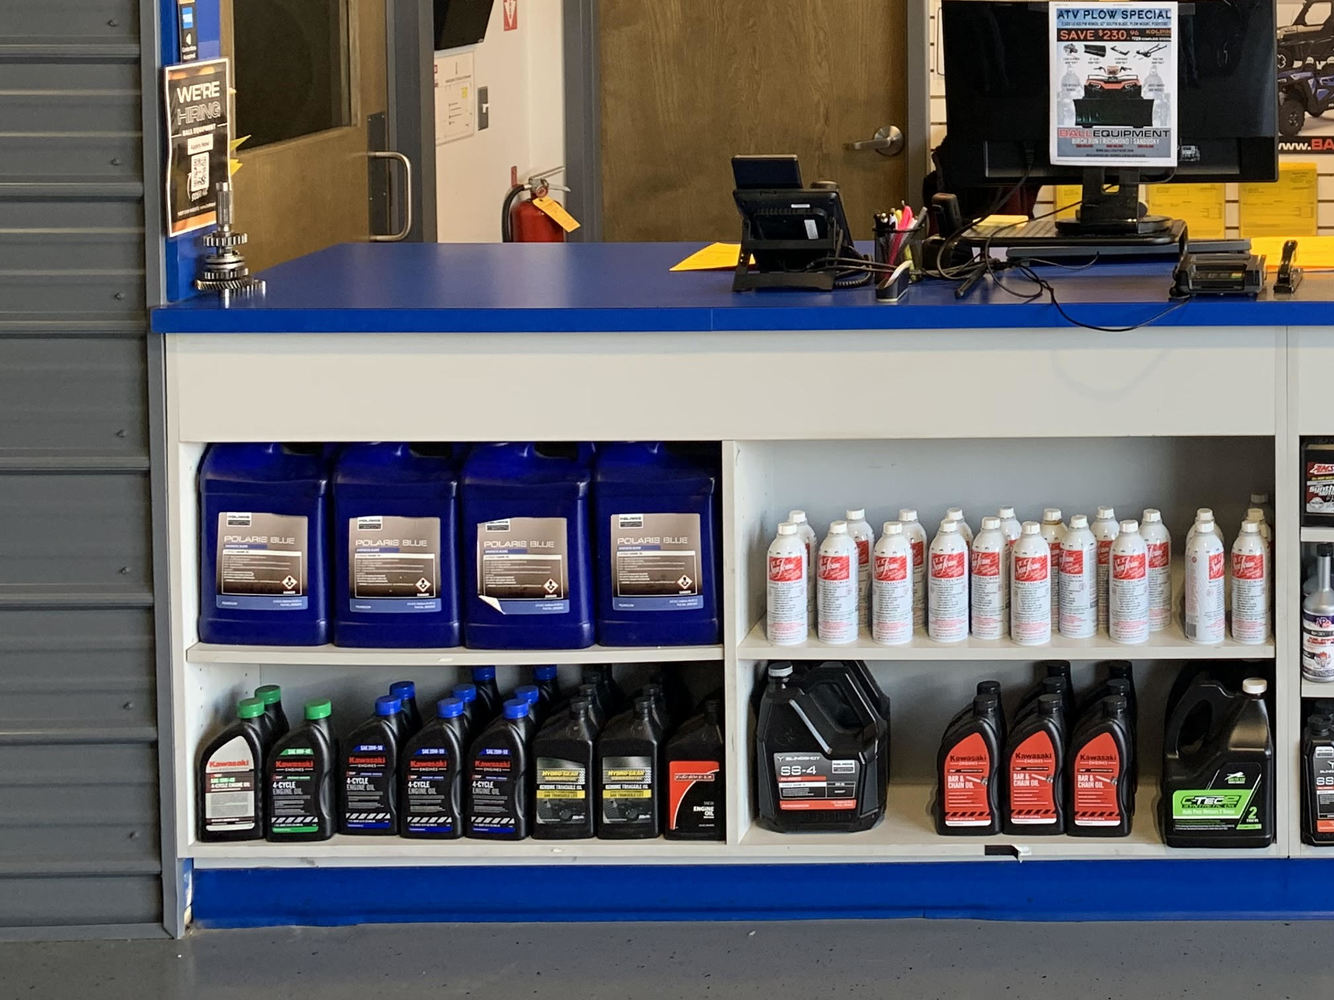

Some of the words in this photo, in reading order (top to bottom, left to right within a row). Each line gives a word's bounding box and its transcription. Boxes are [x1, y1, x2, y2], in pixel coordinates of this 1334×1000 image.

[1057, 10, 1080, 19] ATV
[1084, 10, 1117, 19] PLOW
[1121, 10, 1171, 19] SPECIAL
[1060, 31, 1094, 39] SAVE
[177, 81, 220, 104] WE'RE
[224, 535, 267, 543] POLARIS
[270, 536, 295, 544] BLUE
[355, 539, 399, 547] POLARIS
[402, 539, 427, 547] BLUE
[617, 537, 660, 545] POLARIS
[484, 540, 527, 548] POLARIS
[530, 540, 554, 548] BLUE
[950, 755, 987, 763] Kawasaki
[209, 760, 249, 768] Kawasaki
[275, 760, 314, 768] Kawasaki
[781, 766, 817, 776] SS-4
[1248, 807, 1257, 819] 2
